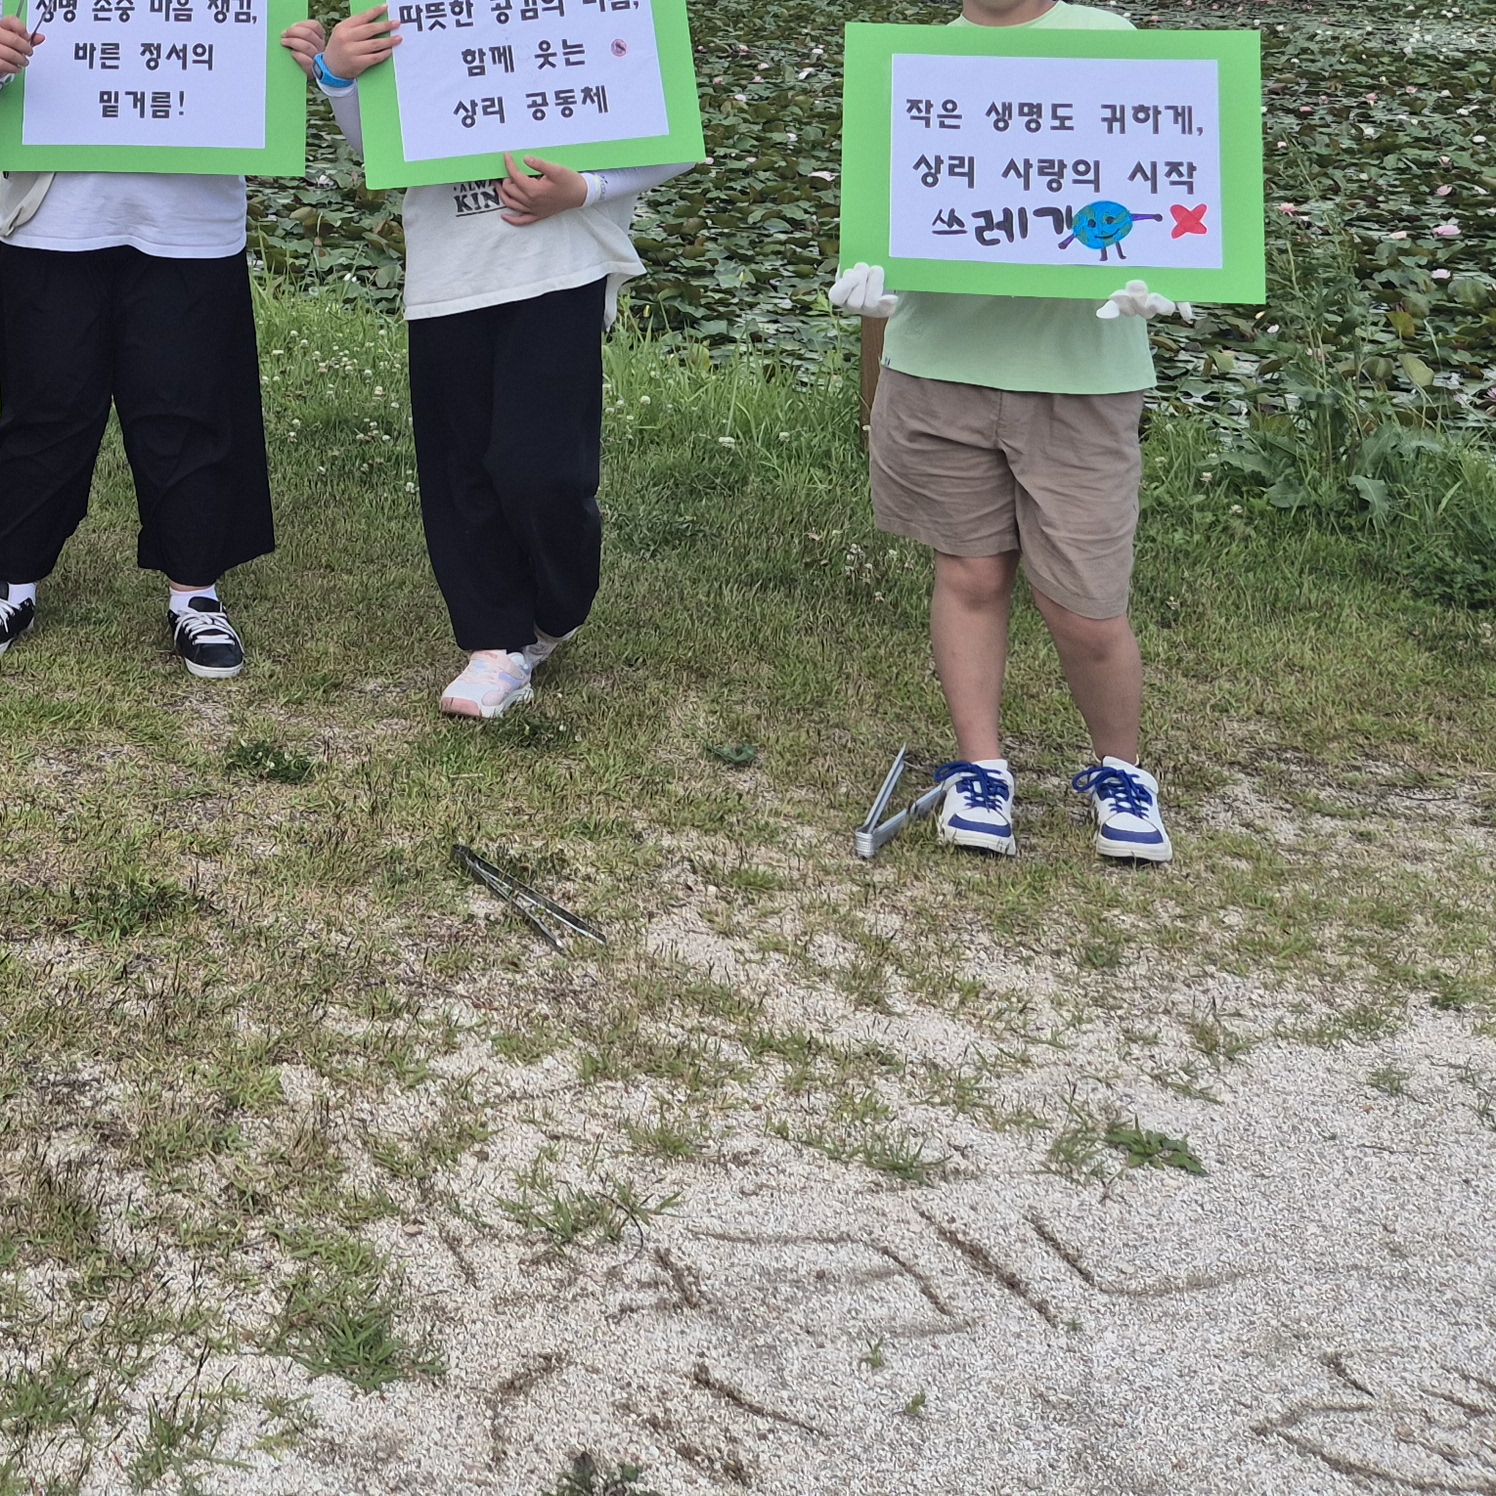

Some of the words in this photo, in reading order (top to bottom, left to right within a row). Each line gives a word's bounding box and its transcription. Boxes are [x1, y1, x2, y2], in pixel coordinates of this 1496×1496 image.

[399, 0, 473, 31] 따뜻한
[74, 43, 120, 69] 바른
[140, 43, 213, 71] 정서의
[461, 45, 514, 77] 함께
[535, 39, 585, 69] 웃는
[99, 91, 184, 118] 밑거름!
[454, 96, 505, 128] 상리
[526, 85, 608, 121] 공동체
[907, 99, 962, 129] 작은
[986, 102, 1074, 133] 생명도
[1101, 104, 1203, 136] 귀하게,
[913, 154, 974, 189] 상리
[1002, 158, 1100, 193] 사랑의
[1128, 161, 1197, 194] 시작
[932, 205, 1073, 245] 쓰레기
